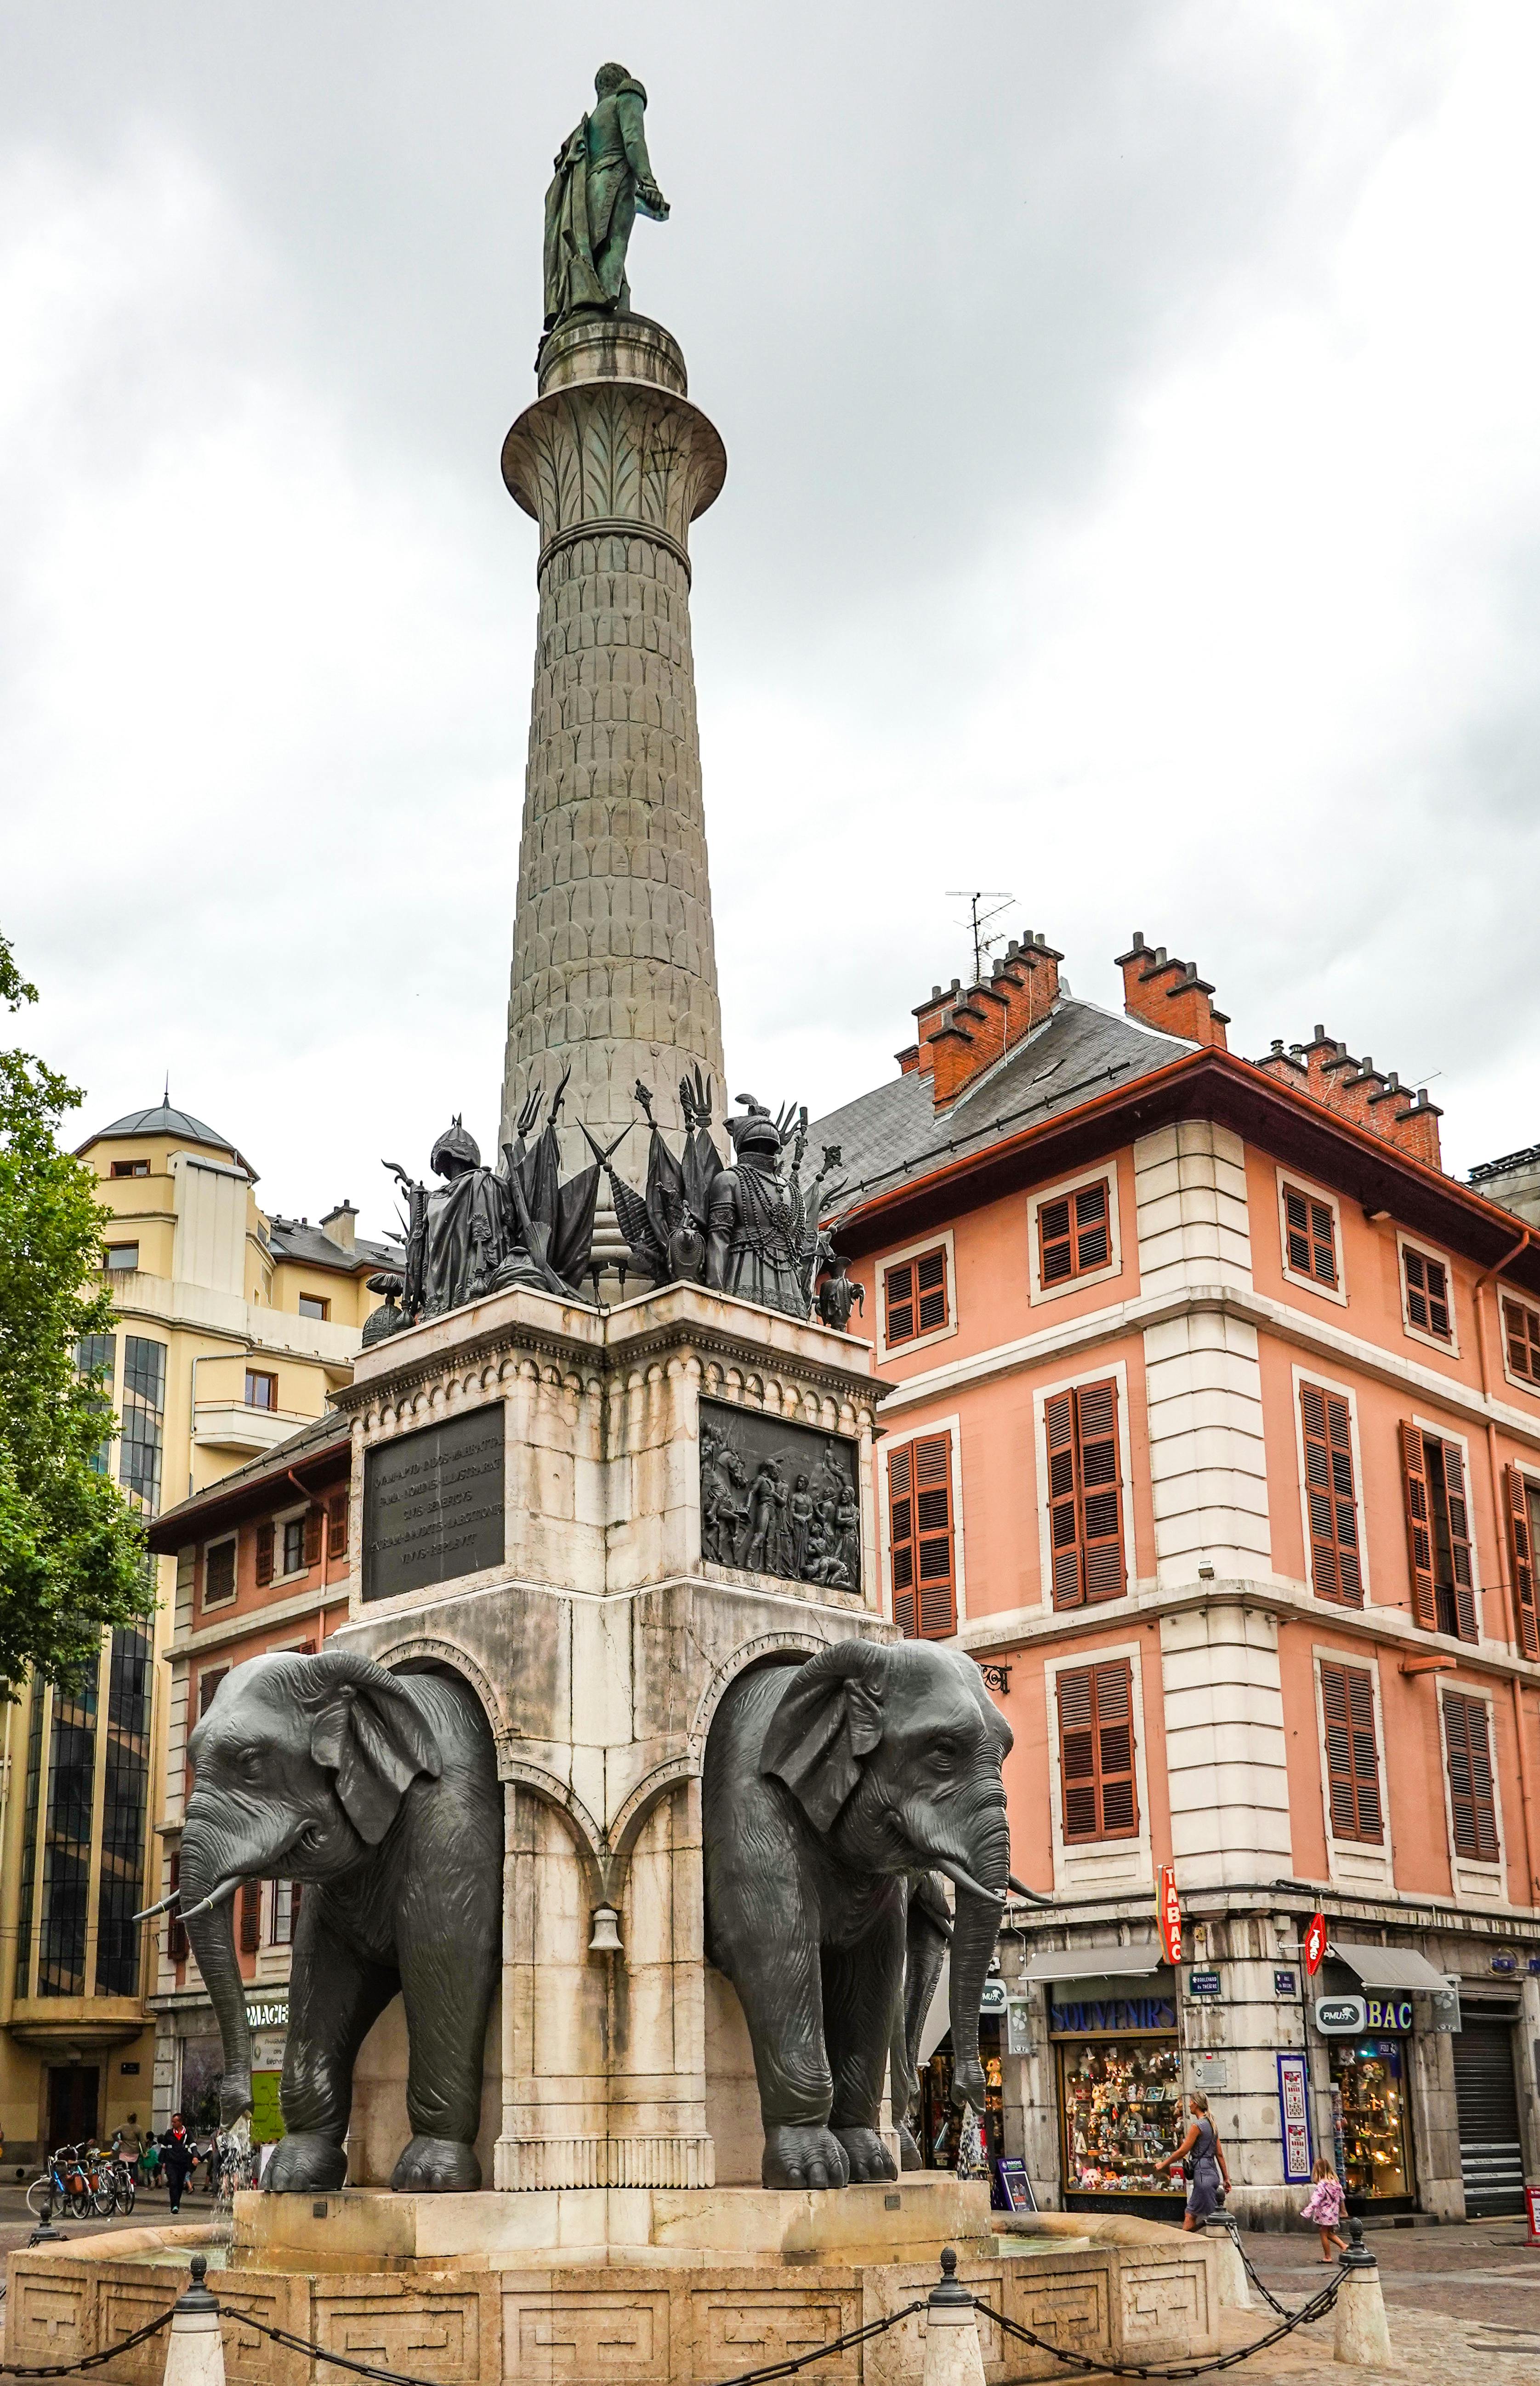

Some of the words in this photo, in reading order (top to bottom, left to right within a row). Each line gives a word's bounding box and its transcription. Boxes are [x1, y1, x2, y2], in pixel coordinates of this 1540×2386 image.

[1165, 1868, 1181, 1960] TABAC
[1051, 2000, 1175, 2032] SOUVENIRS
[1323, 2011, 1342, 2020] PMU
[1368, 2001, 1412, 2029] BAC
